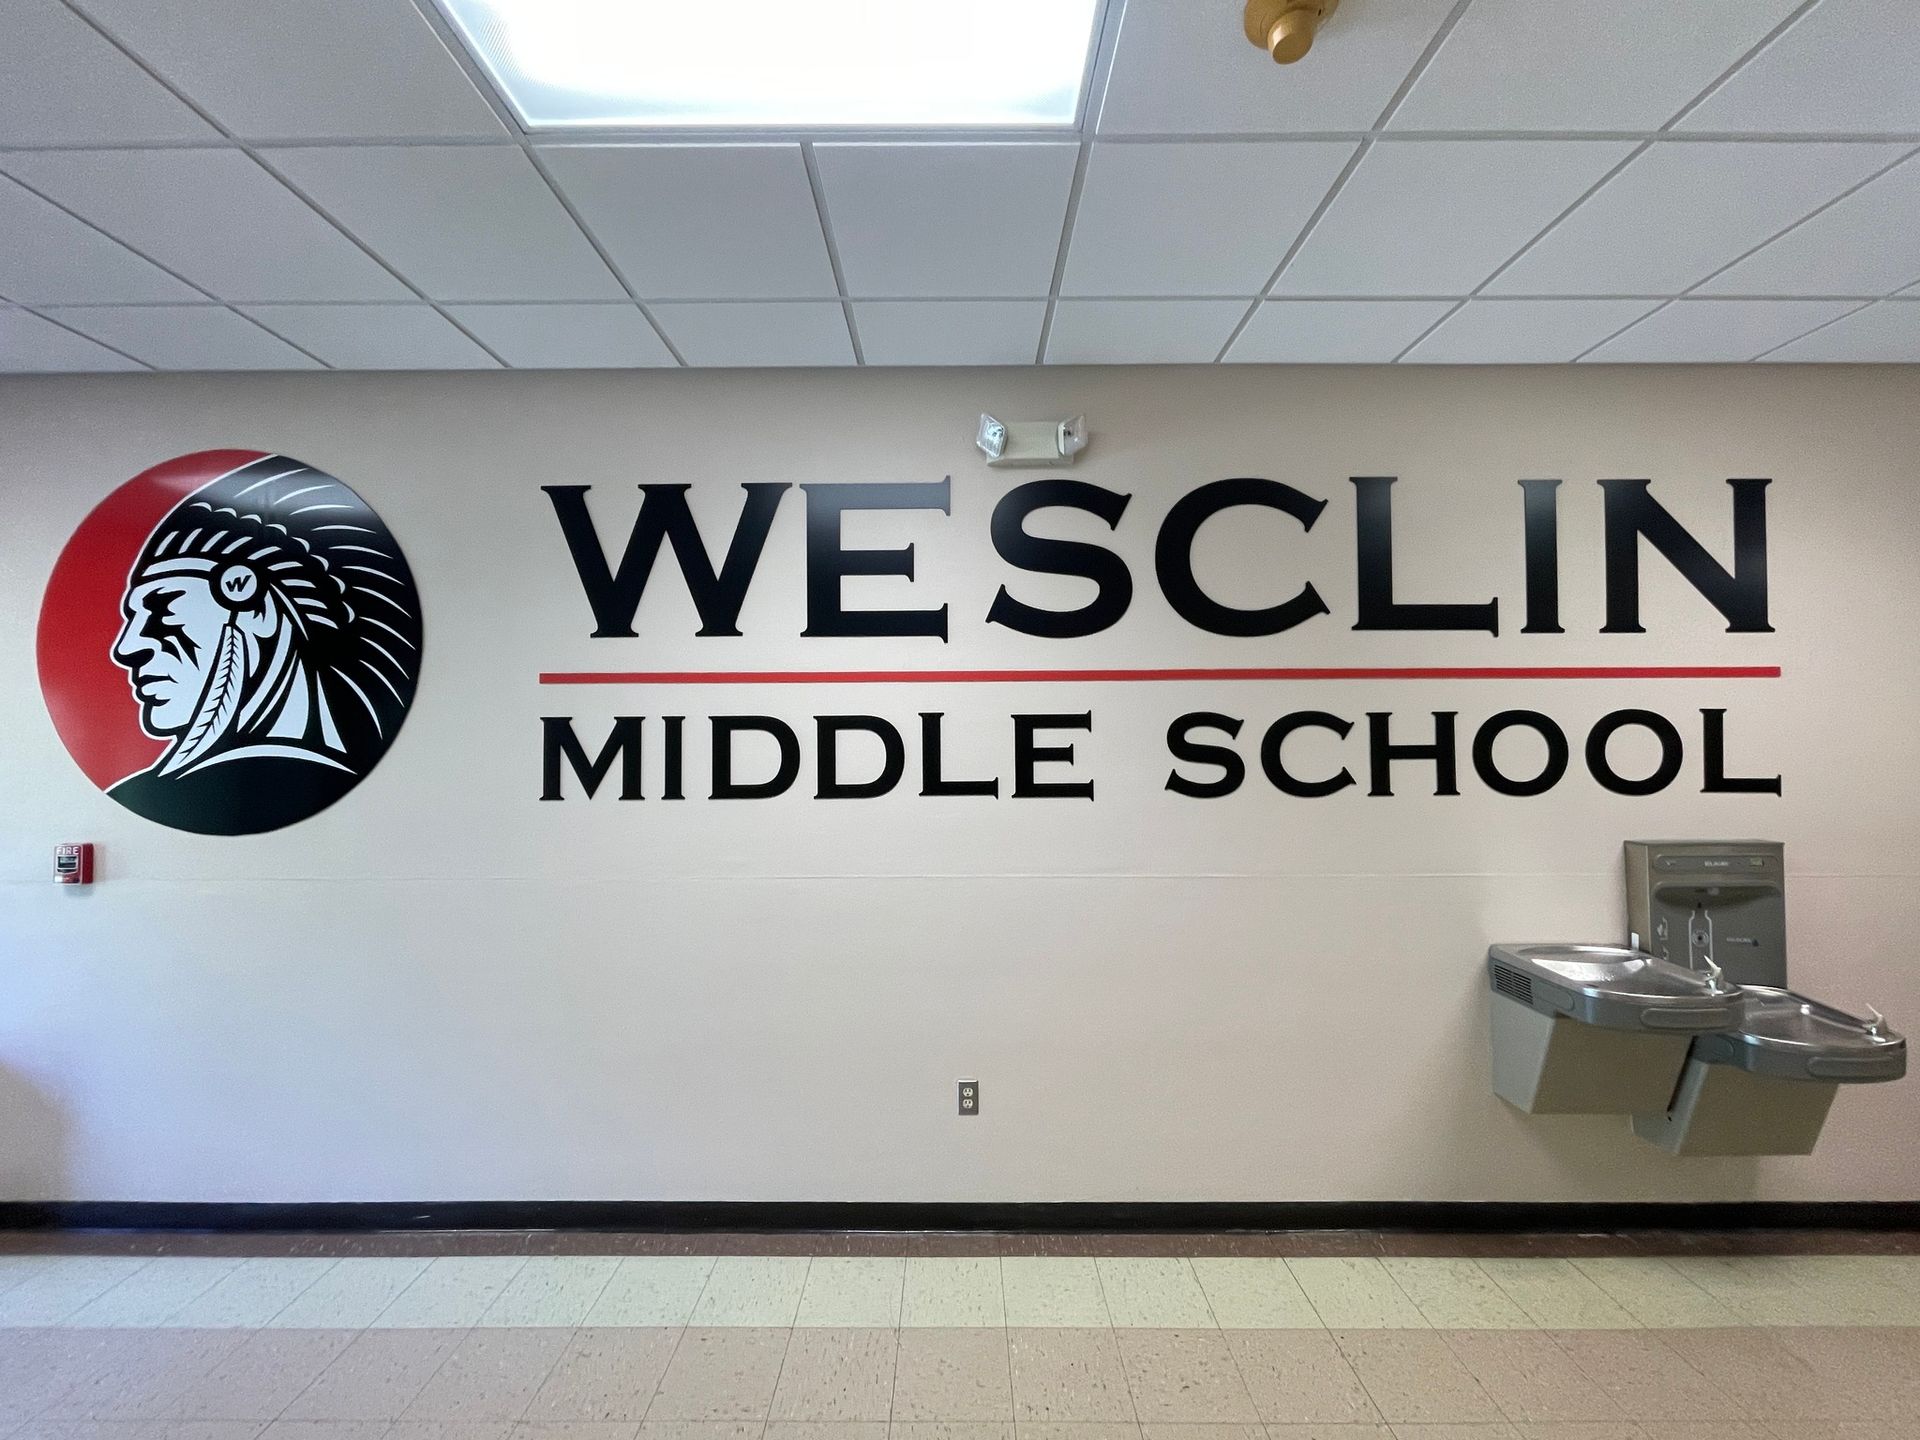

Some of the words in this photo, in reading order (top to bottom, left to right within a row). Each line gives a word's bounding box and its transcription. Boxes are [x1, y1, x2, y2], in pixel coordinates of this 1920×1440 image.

[225, 574, 253, 593] W
[541, 476, 1774, 642] WESCLIN
[540, 711, 1093, 803] MIDDLE
[1165, 708, 1780, 797] SCHOOL
[56, 846, 80, 855] FIRE
